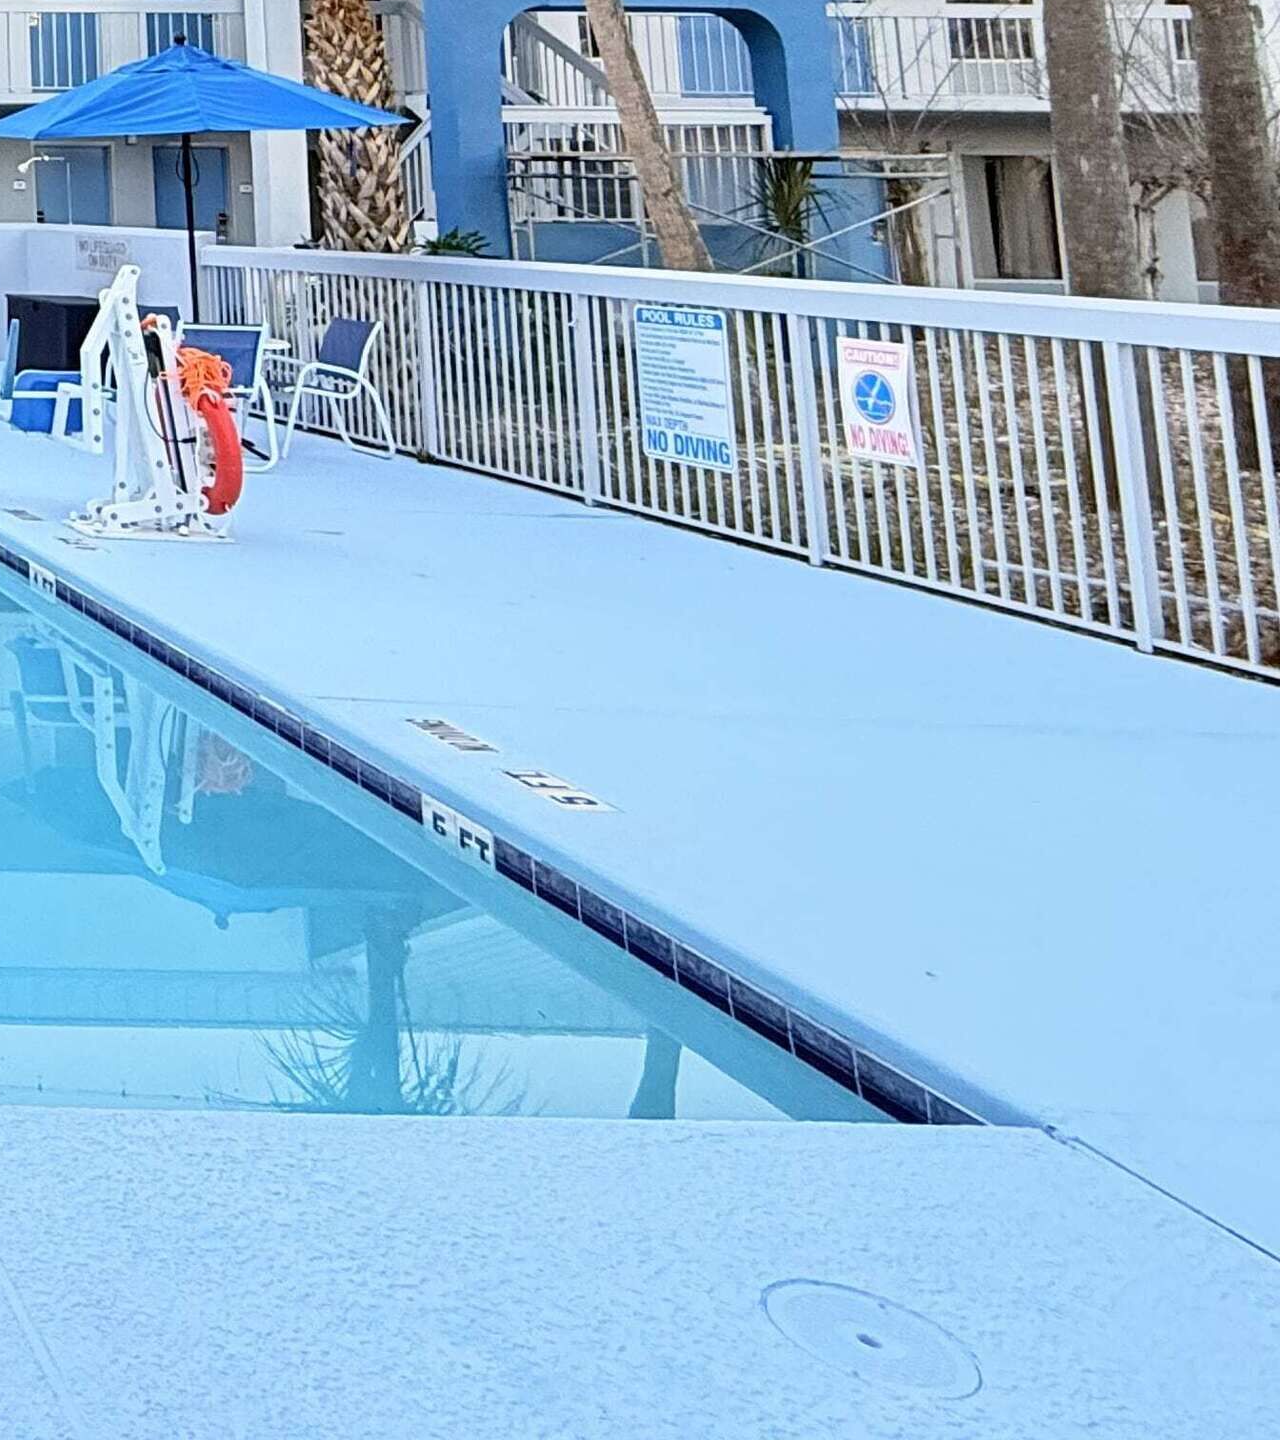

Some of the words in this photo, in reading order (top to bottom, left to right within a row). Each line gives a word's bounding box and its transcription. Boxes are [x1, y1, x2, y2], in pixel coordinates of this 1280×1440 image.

[641, 310, 672, 324] POOL
[673, 312, 715, 329] RULES
[648, 428, 668, 453] NO
[673, 433, 731, 465] DIVING
[850, 424, 865, 449] NO
